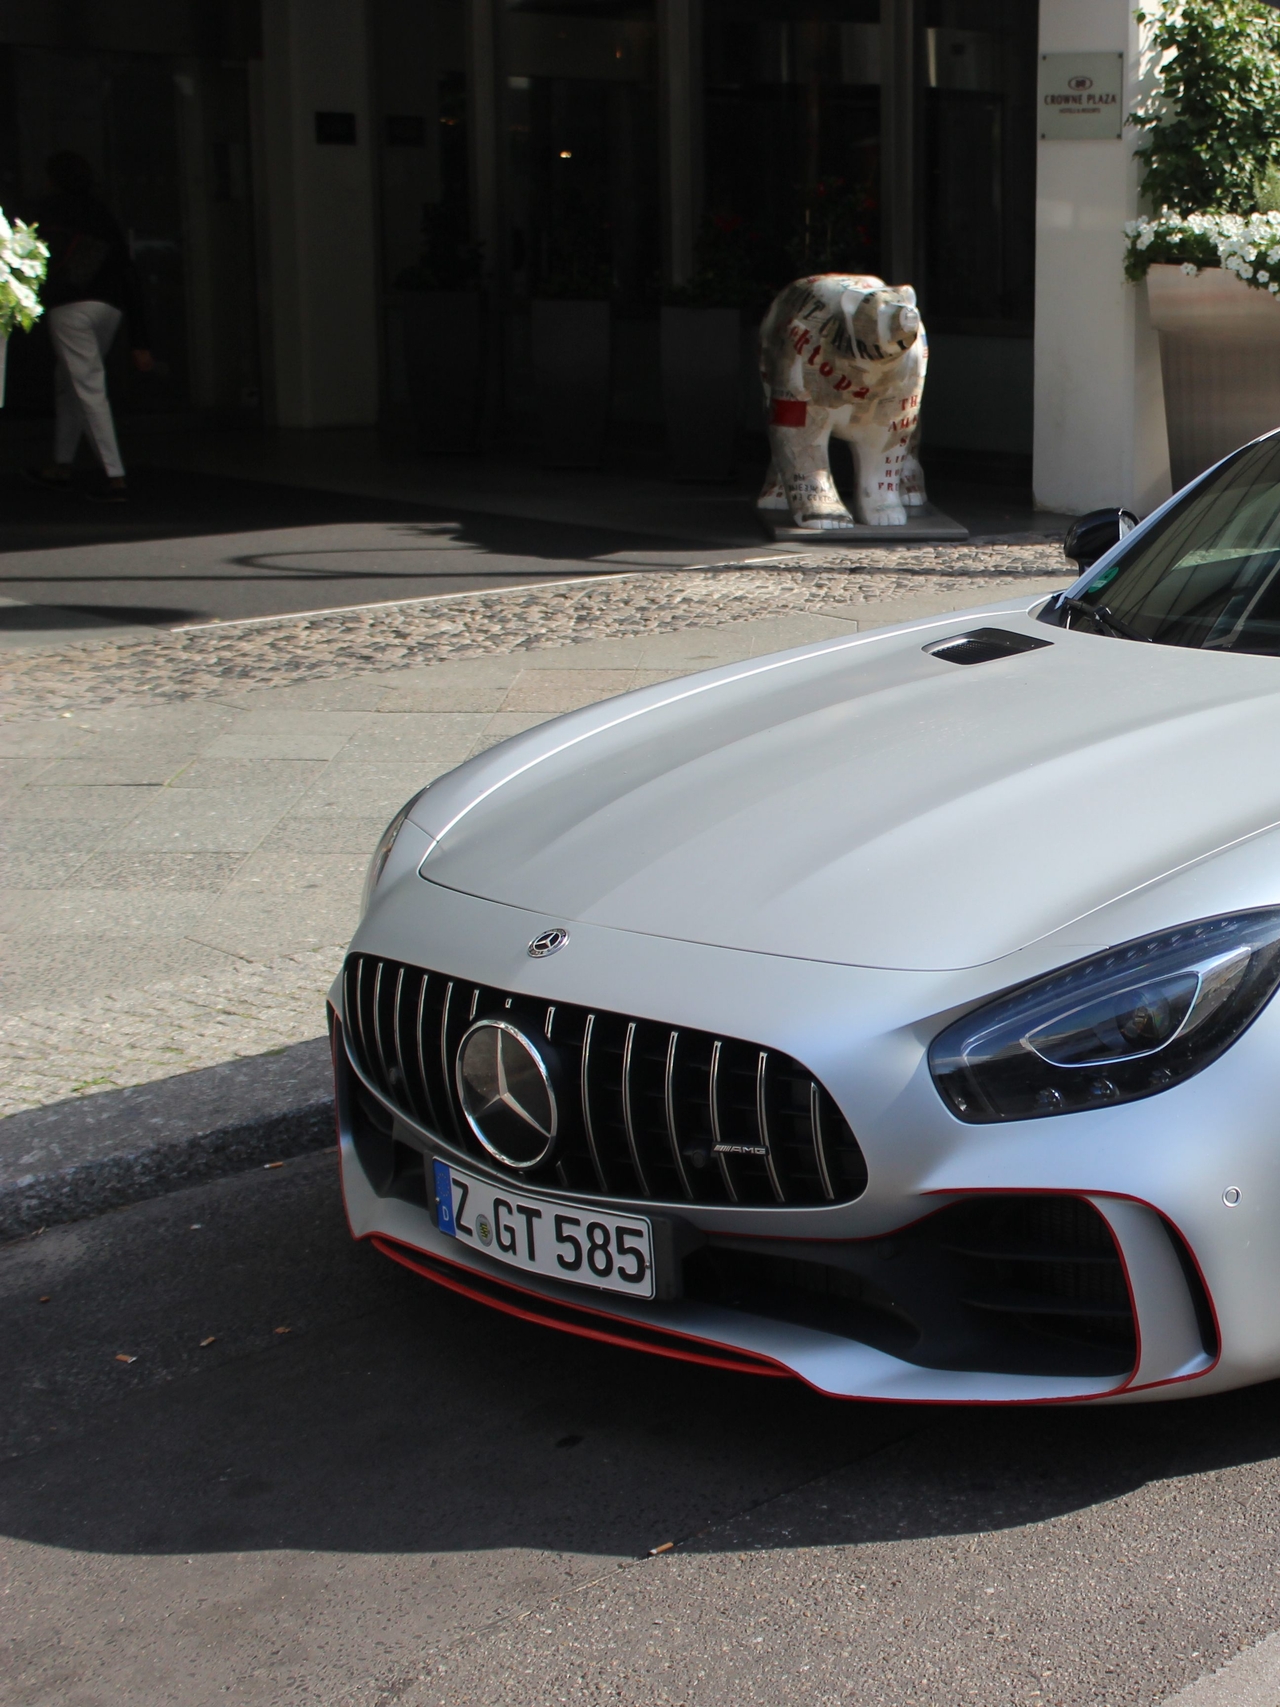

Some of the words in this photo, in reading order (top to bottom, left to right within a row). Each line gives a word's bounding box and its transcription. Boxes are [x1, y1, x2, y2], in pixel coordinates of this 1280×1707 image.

[1044, 94, 1083, 105] CROWNE
[1087, 94, 1117, 105] PLAZA
[730, 1146, 766, 1155] AMG
[442, 1205, 450, 1222] D
[451, 1177, 474, 1237] Z
[493, 1197, 542, 1262] GT
[554, 1213, 646, 1284] 585
